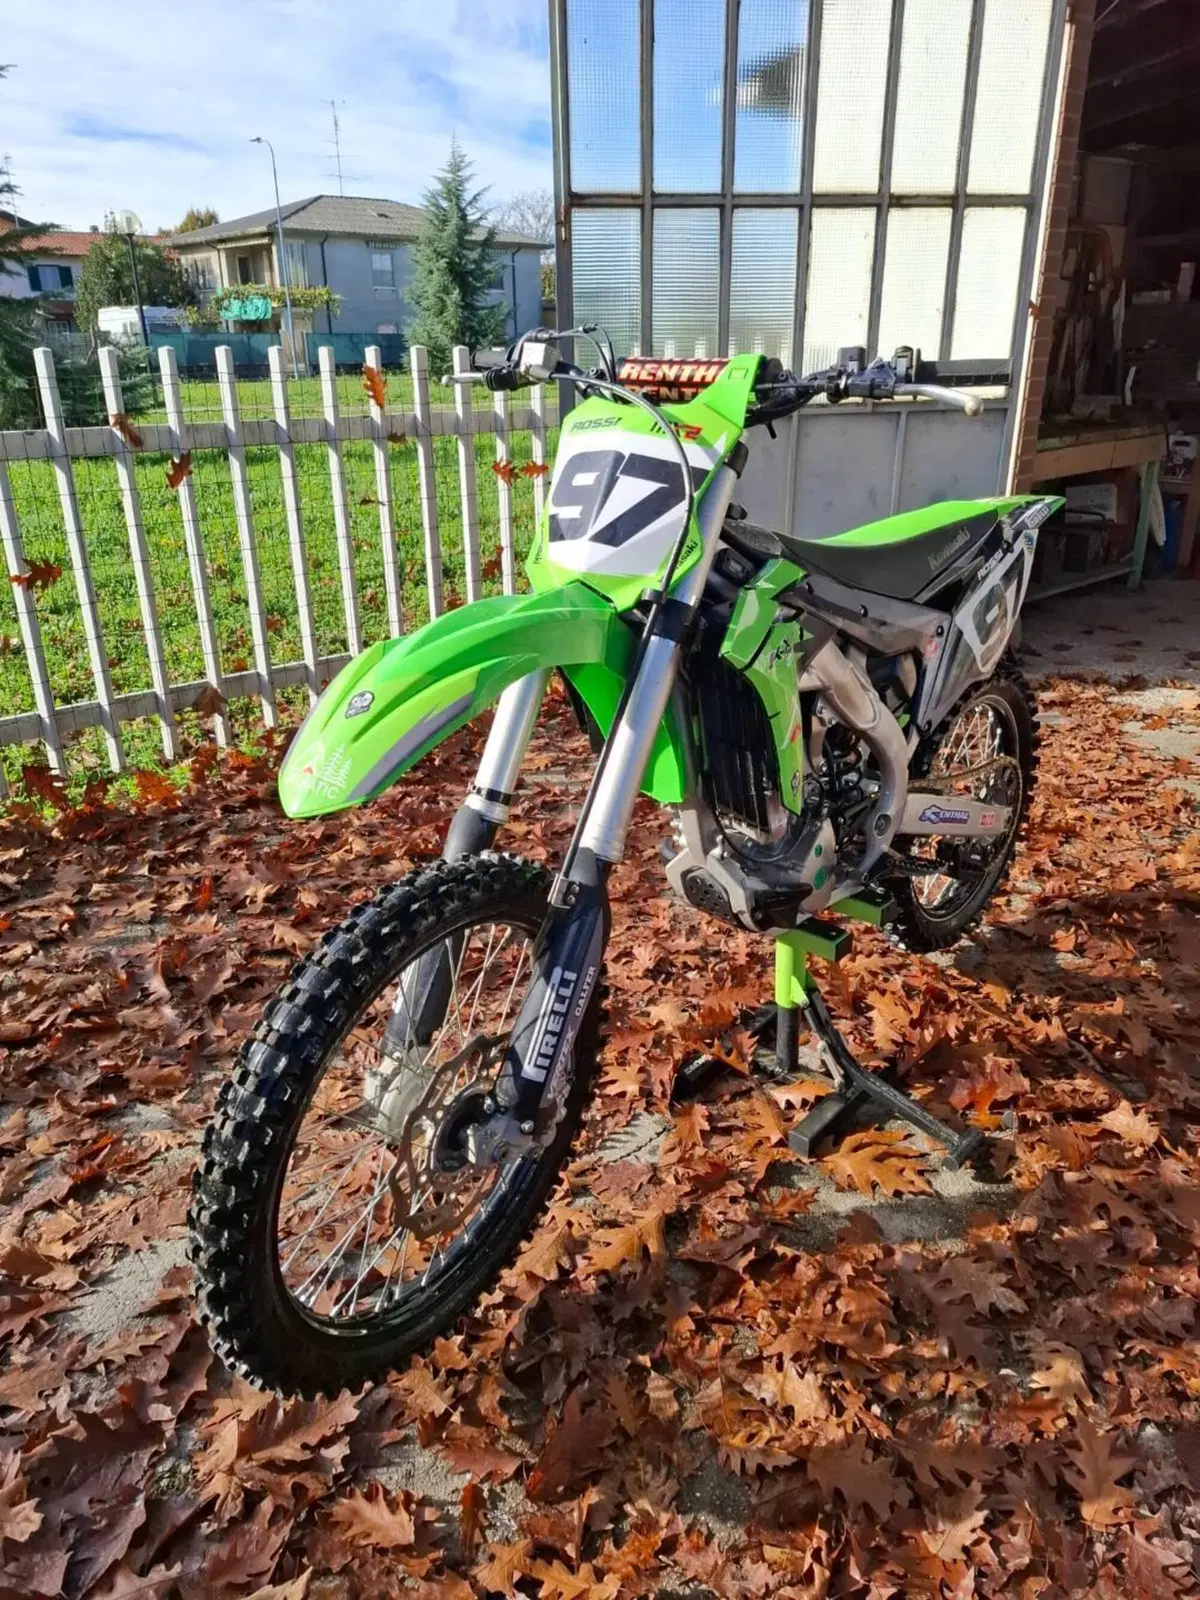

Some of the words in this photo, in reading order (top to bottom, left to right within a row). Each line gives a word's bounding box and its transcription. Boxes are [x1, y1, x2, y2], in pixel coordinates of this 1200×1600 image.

[619, 362, 722, 382] RENTH
[571, 417, 621, 431] ROSSI
[550, 450, 712, 547] 97
[927, 527, 969, 569] Kawasaki
[977, 548, 1003, 580] ROSSI
[575, 965, 597, 1017] GALFER
[521, 966, 578, 1083] PIRELLI
